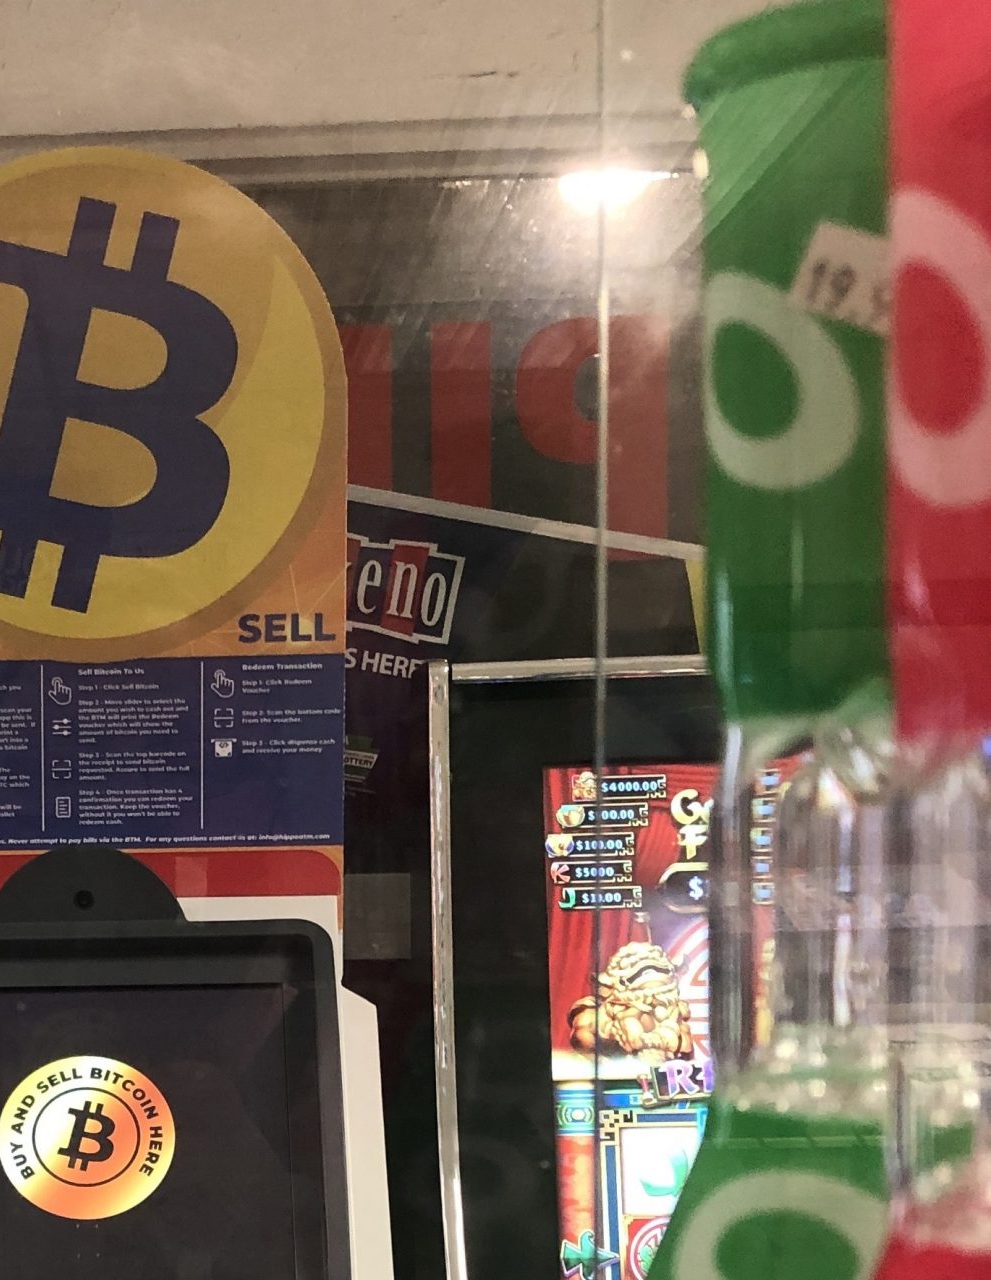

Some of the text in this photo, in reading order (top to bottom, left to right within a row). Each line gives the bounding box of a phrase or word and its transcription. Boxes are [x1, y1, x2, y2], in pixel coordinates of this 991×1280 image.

[238, 613, 336, 643] SELL
[276, 662, 323, 670] Transaction
[344, 756, 373, 767] OTTERY
[30, 837, 58, 845] attempt
[173, 835, 207, 843] questions
[10, 1068, 163, 1180] BUY AND SELL BITCOIN HERE
